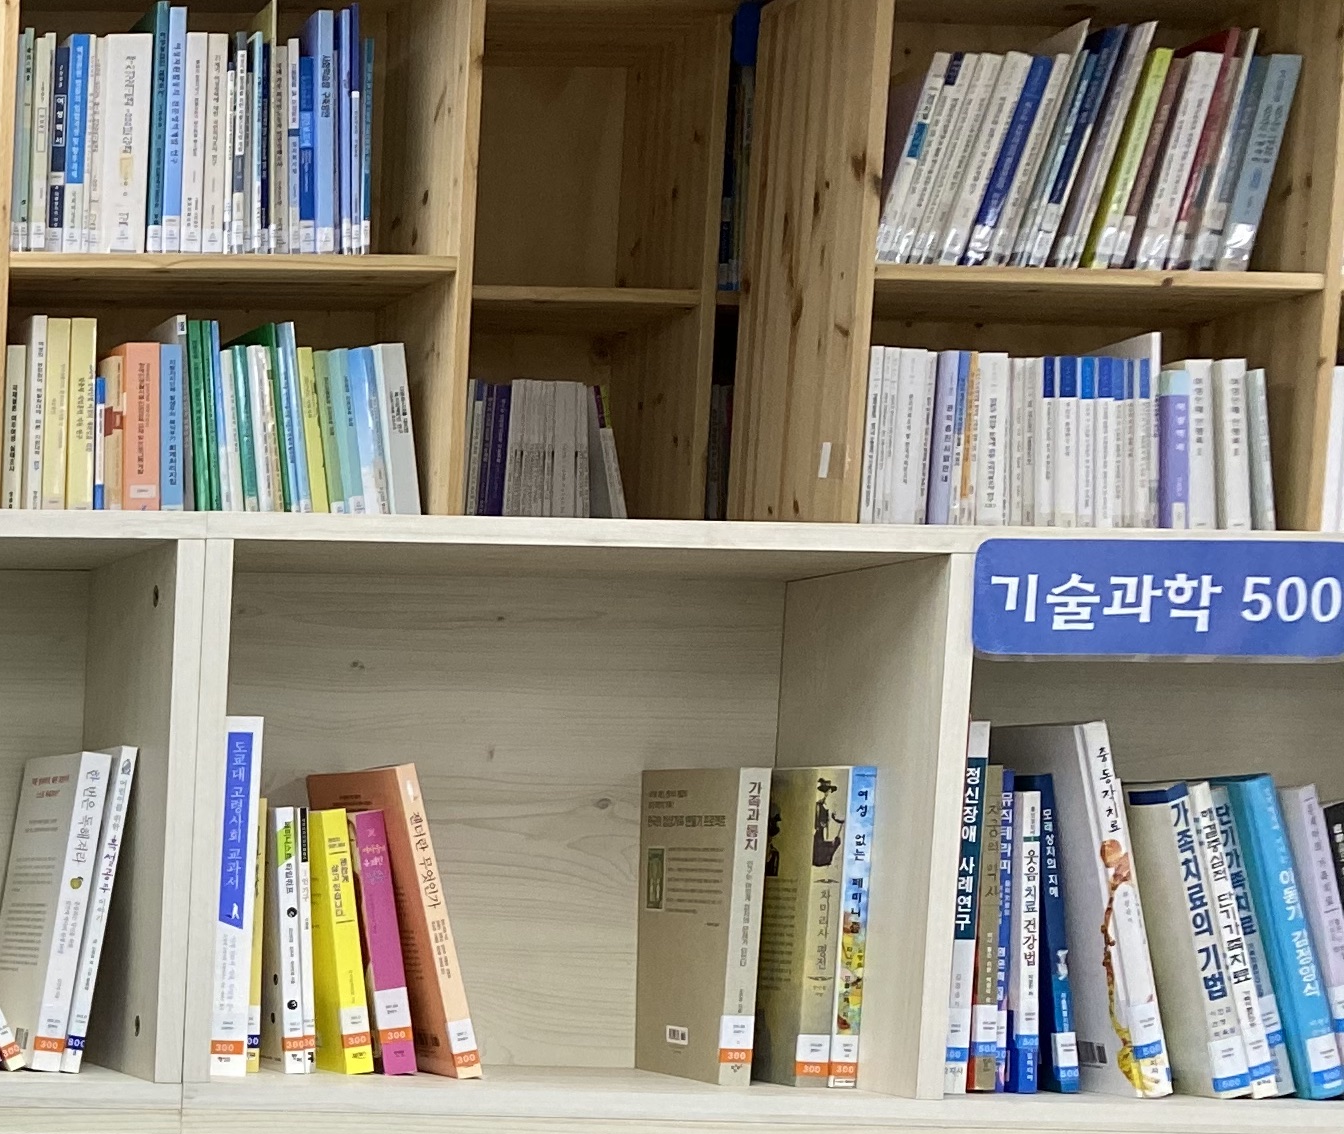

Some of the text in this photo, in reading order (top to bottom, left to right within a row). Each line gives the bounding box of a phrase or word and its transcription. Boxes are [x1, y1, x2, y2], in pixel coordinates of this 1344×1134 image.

[990, 573, 1343, 633] 기술과학 500
[228, 785, 246, 844] 고령사회
[856, 790, 869, 818] 여성
[225, 848, 243, 890] 교과서
[409, 811, 442, 911] 젠더란 무엇인가
[954, 767, 983, 932] 정신장애 사례연구
[1023, 849, 1038, 913] 웃음치료
[1170, 801, 1228, 1001] 가족치료의 기법
[1023, 917, 1036, 966] 건강법
[1217, 892, 1252, 985] 단기가족치료
[40, 1040, 59, 1049] 300
[387, 1030, 406, 1040] 300
[727, 1051, 746, 1061] 300
